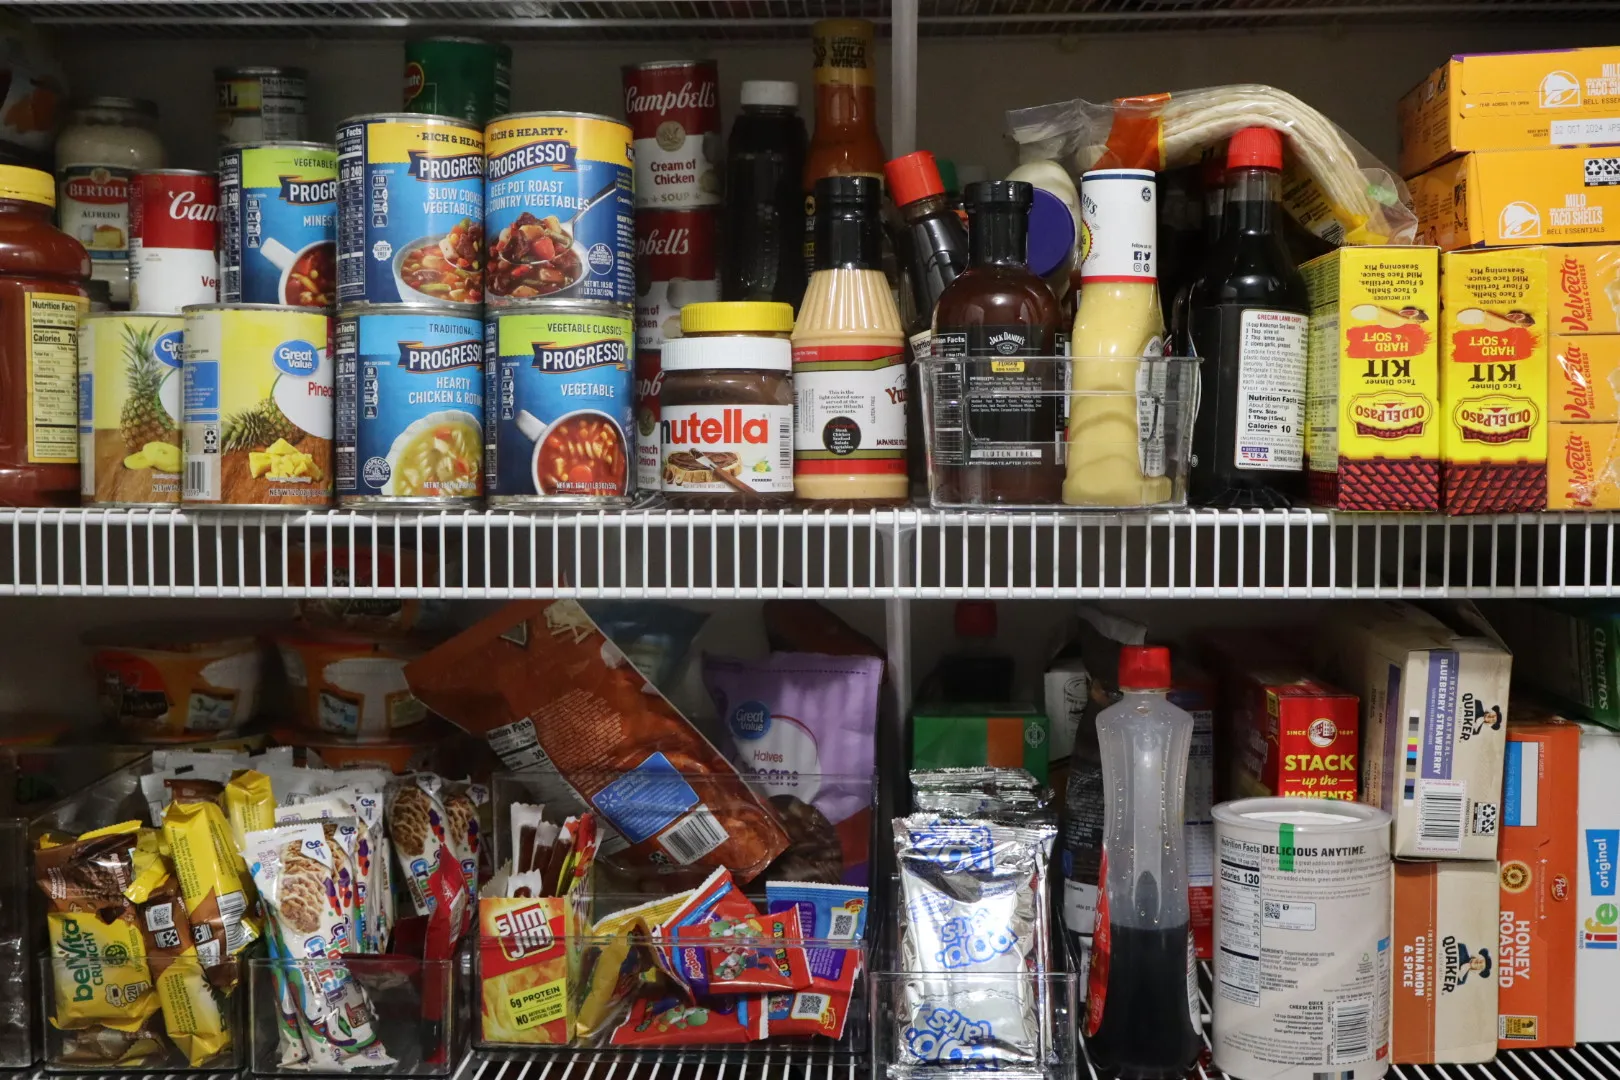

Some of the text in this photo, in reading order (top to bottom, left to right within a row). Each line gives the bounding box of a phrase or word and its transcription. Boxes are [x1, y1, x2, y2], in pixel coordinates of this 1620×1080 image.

[422, 132, 458, 143] RICH &
[508, 128, 514, 137] &
[516, 127, 565, 137] HEARTY
[294, 158, 336, 169] VEGETABLE
[489, 143, 567, 179] PROGRESSO
[651, 159, 697, 172] Cream of
[654, 173, 695, 186] Chicken
[428, 187, 457, 200] SLOW
[490, 180, 564, 198] BEEF POT ROAST
[489, 195, 590, 213] COUNTRY VEGETABLES
[1565, 194, 1587, 208] MILD
[423, 201, 473, 217] VEGETABLE
[1550, 211, 1603, 226] TACO SHELLS
[1485, 267, 1525, 275] Seasoning
[1560, 257, 1589, 332] Velveeta
[1578, 264, 1593, 321] SHELLS CHEESE
[32, 300, 61, 311] Nutrition
[429, 323, 474, 336] TRADITIONAL
[547, 322, 622, 336] VEGETABLE CLASSICS
[33, 333, 61, 343] Calories
[946, 336, 965, 344] Facts
[988, 331, 1026, 346] JACK DANIEL'S
[1362, 332, 1392, 342] SOFT
[1469, 336, 1499, 346] SOFT
[279, 347, 313, 362] Great
[1375, 342, 1409, 352] HARD
[1481, 346, 1515, 356] HARD
[542, 343, 625, 370] PROGRESSO
[288, 359, 313, 370] Value
[1362, 359, 1410, 378] KIT
[1581, 352, 1593, 378] CHEESE
[1467, 364, 1516, 382] KIT
[436, 377, 471, 390] HEARTY
[560, 383, 615, 398] VEGETABLE
[408, 391, 462, 405] CHICKEN &
[1248, 394, 1281, 402] Nutrition
[661, 408, 769, 446] nutella
[1281, 425, 1291, 434] 10
[1584, 440, 1593, 468] CHEESE
[1437, 658, 1449, 711] BLUEBERRY
[735, 708, 765, 722] Great
[1444, 676, 1456, 757] INSTANT OATMEAL
[1460, 692, 1474, 742] QUAKER
[740, 721, 764, 732] Value
[1432, 713, 1444, 775] STRAWBERRY
[753, 749, 784, 763] Halves
[1284, 754, 1355, 772] STACK
[1301, 775, 1338, 786] up the
[1220, 837, 1260, 854] Nutrition Facts
[1262, 844, 1318, 857] DELICIOUS
[1594, 838, 1611, 888] original
[1220, 868, 1260, 885] Calories 130
[1554, 876, 1566, 897] Post
[1584, 902, 1619, 950] life
[510, 924, 552, 959] jim
[1499, 910, 1515, 988] ROASTED
[1515, 920, 1531, 980] HONEY
[56, 918, 93, 1003] belVita
[84, 931, 104, 987] CRUNCHY
[1403, 944, 1414, 988] & SPICE
[1414, 936, 1426, 997] CINNAMON
[1442, 935, 1458, 993] QUAKER
[509, 985, 561, 1009] 6g PROTEIN
[515, 1014, 529, 1026] NO
[925, 1007, 992, 1046] tarts
